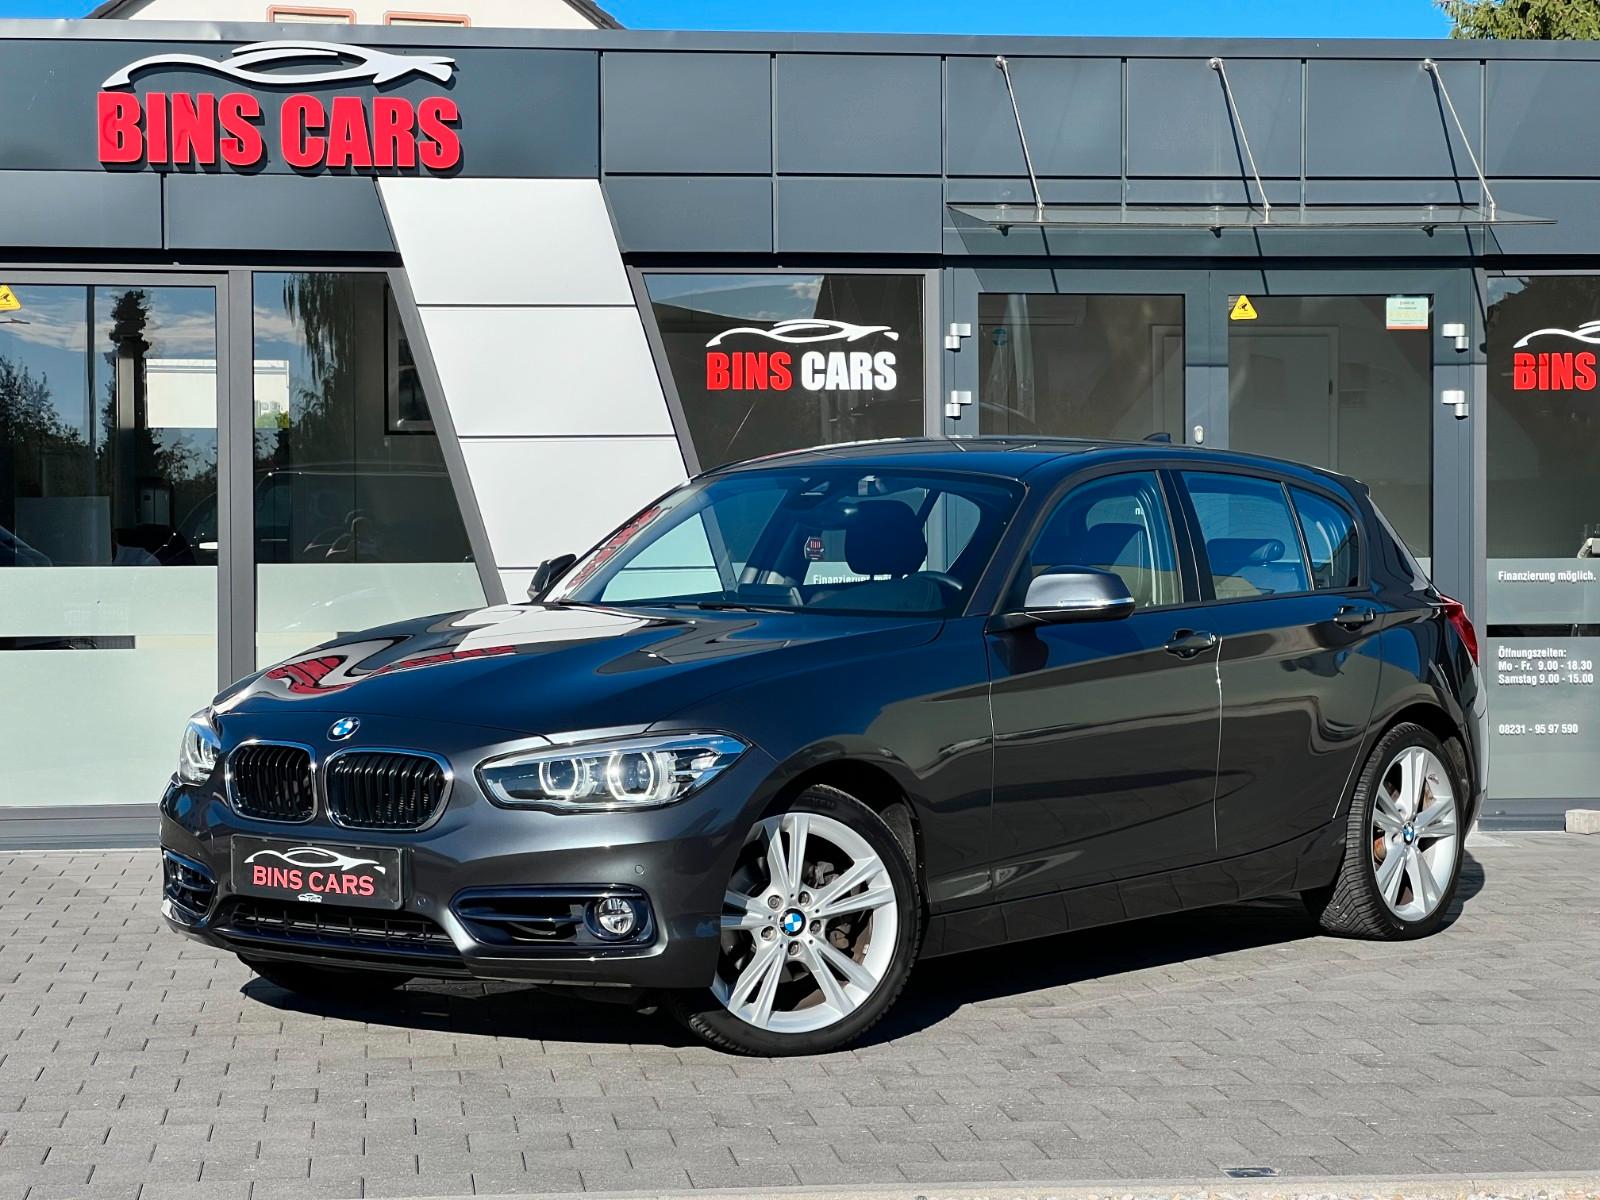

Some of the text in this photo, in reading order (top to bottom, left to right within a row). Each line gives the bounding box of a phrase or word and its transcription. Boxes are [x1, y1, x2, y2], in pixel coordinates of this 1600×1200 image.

[97, 92, 460, 168] BINS CARS
[706, 351, 897, 391] BINS CARS
[1513, 351, 1597, 391] BINS
[1498, 570, 1597, 583] Finanzierung möglich.
[1498, 645, 1567, 660] Öffnungszeiten:
[1498, 661, 1512, 671] Mo
[1520, 660, 1533, 671] Fr.
[1537, 660, 1558, 671] 9.00
[1566, 660, 1592, 671] 18.30
[1498, 674, 1537, 686] Samstag
[1539, 673, 1560, 684] 9.00
[1567, 673, 1594, 683] 15.00
[1498, 724, 1526, 734] 08231
[1534, 723, 1546, 734] 95
[1547, 723, 1559, 734] 97
[1561, 723, 1578, 734] 590
[252, 865, 375, 896] BINS CARS
